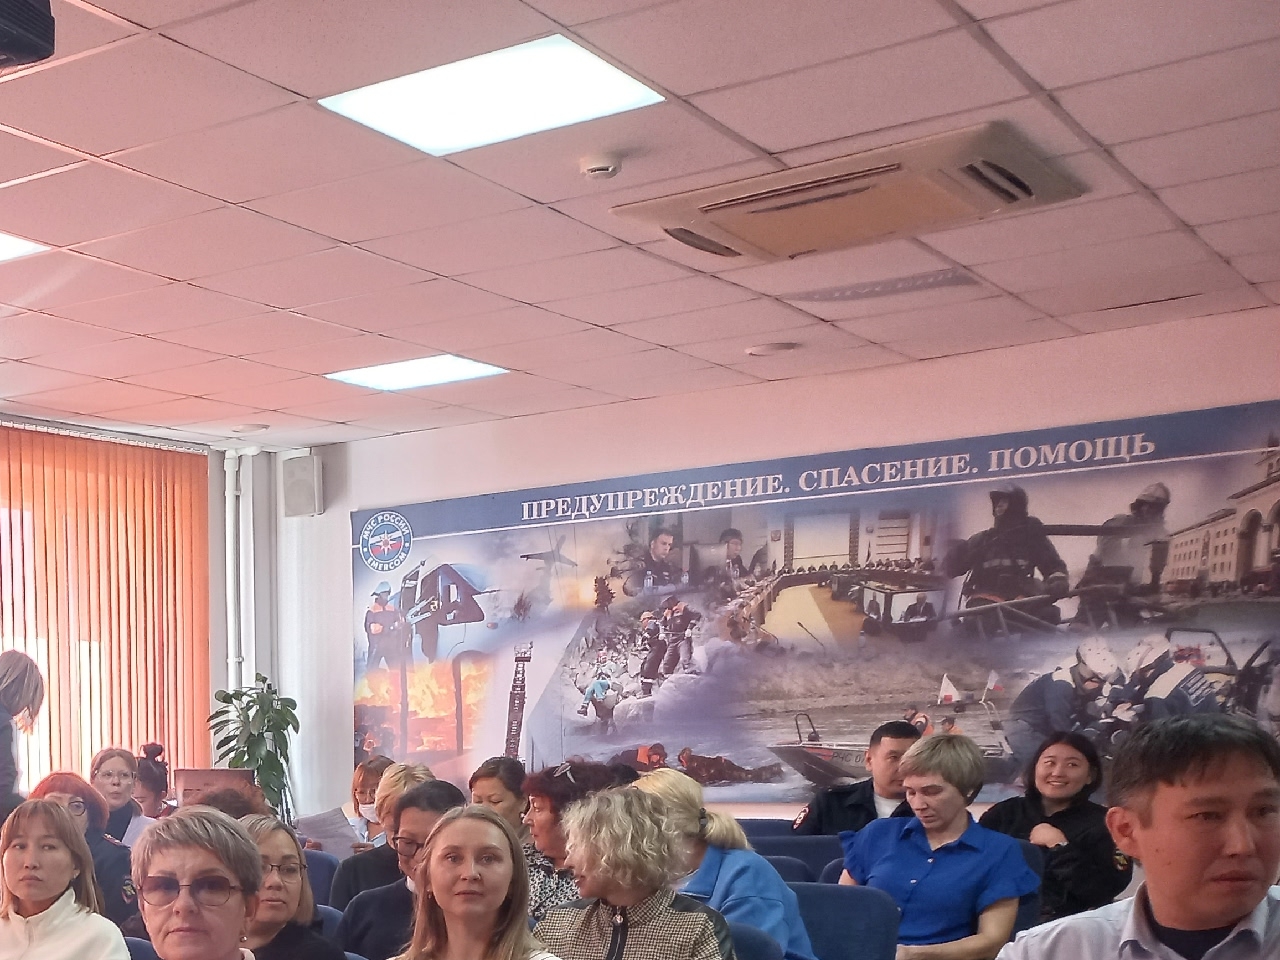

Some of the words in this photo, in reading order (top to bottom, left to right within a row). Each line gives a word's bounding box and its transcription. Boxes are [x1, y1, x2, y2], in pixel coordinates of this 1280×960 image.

[521, 473, 790, 521] ПРЕДУПРЕЖДЕНИЕ.
[799, 453, 978, 491] СПАСЕНИЕ.
[988, 433, 1155, 472] ПОМОЩЬ
[363, 519, 377, 540] МЧС
[377, 513, 410, 535] РОССИИ
[367, 551, 407, 571] EMERCOM
